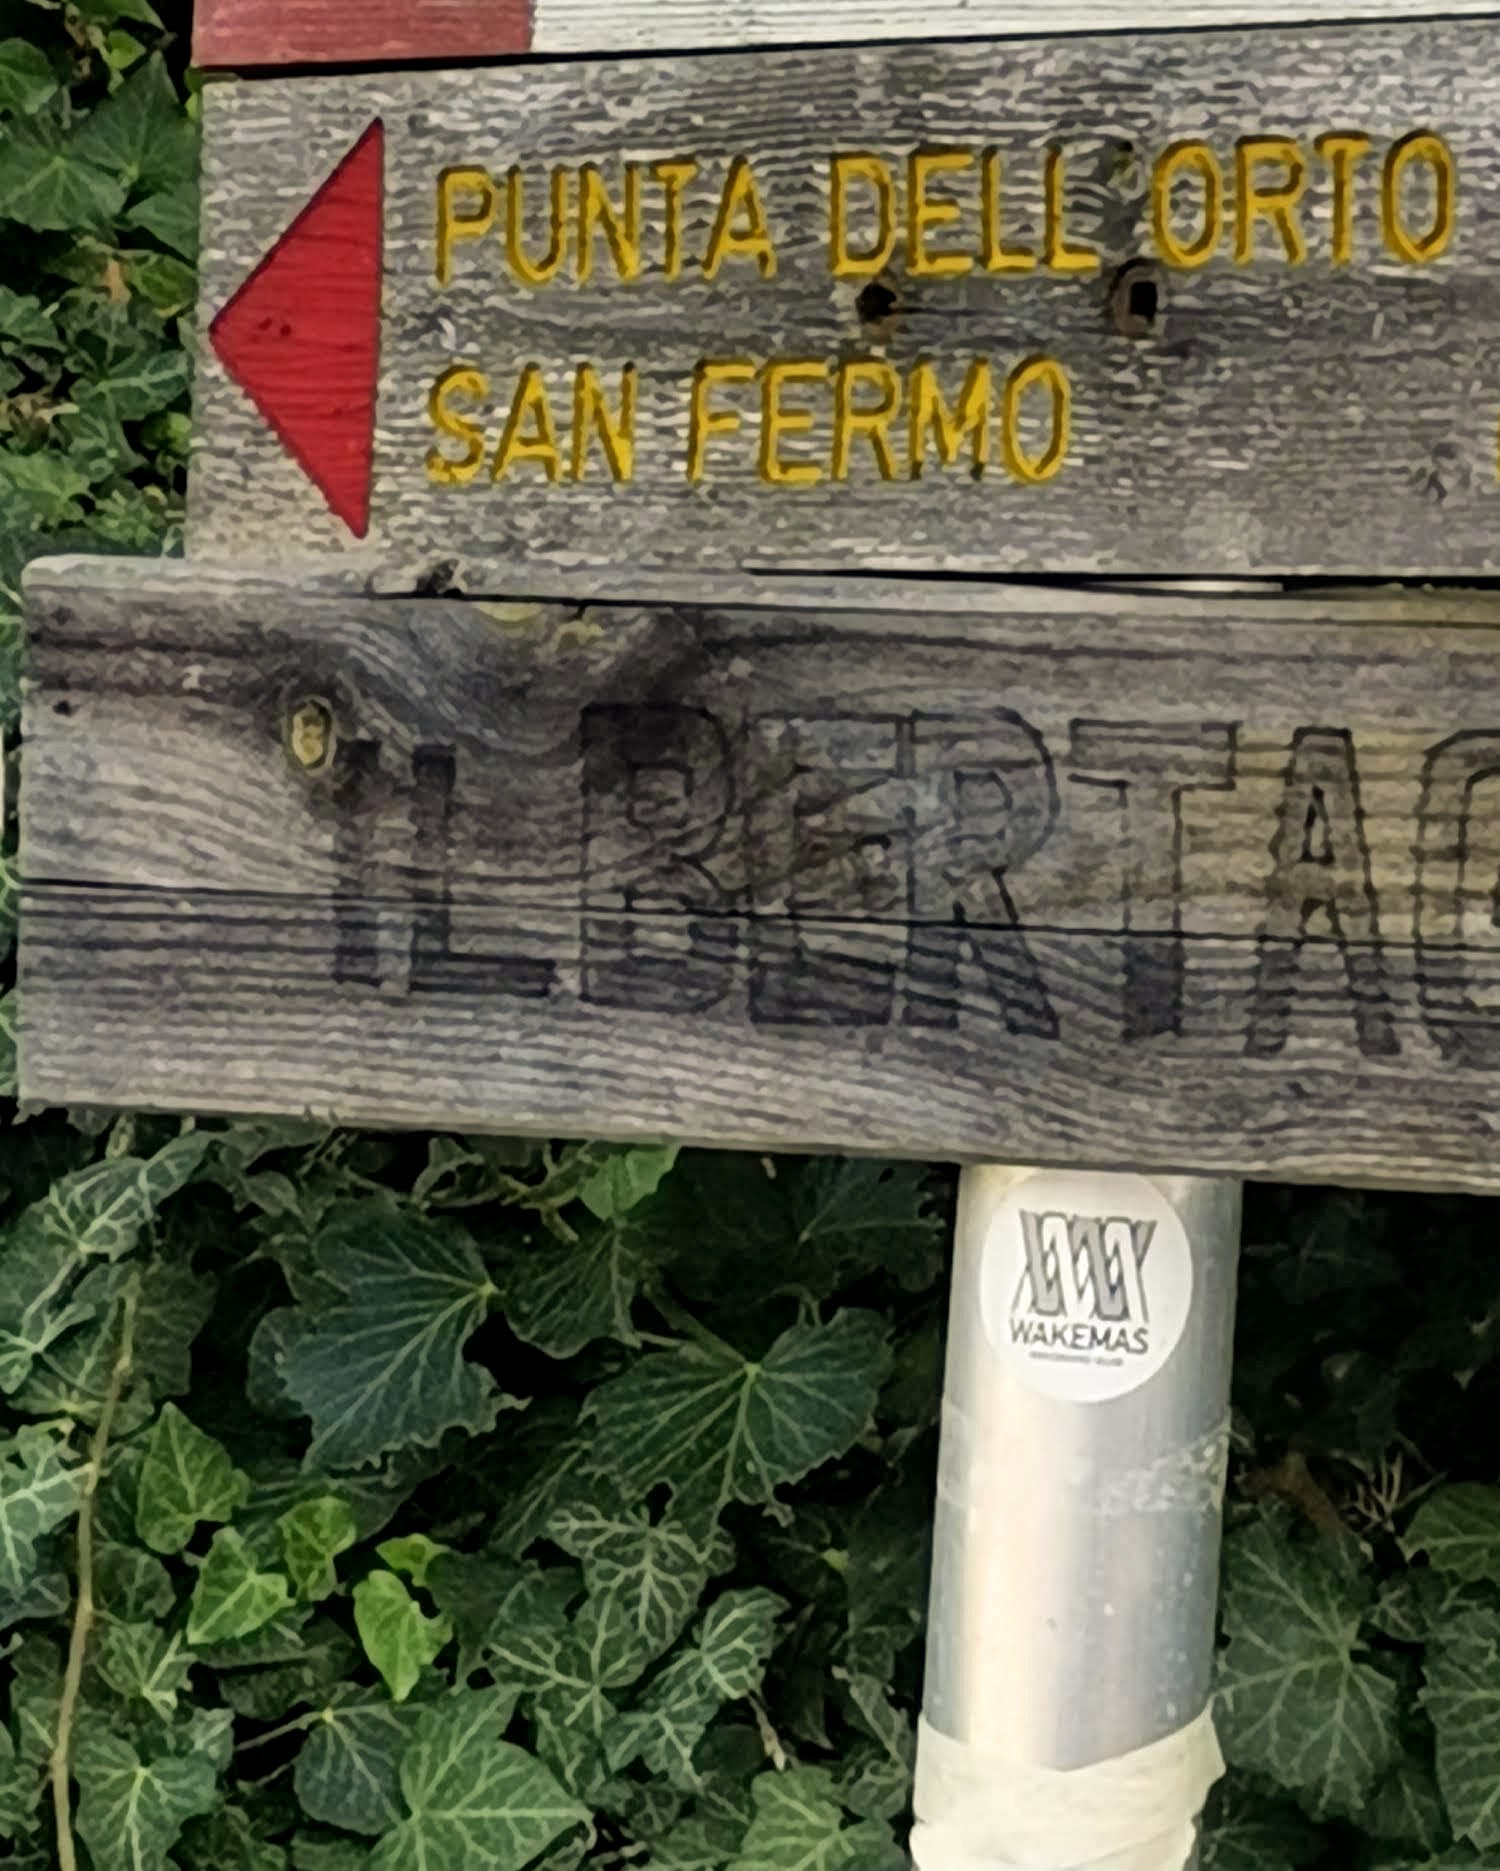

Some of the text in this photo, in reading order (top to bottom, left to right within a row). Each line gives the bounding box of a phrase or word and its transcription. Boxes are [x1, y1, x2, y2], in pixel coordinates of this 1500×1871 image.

[435, 154, 777, 285] PUNTA
[426, 361, 641, 484] SAN
[687, 354, 1072, 484] FERMO
[1009, 1318, 1150, 1355] WAKEMAS
